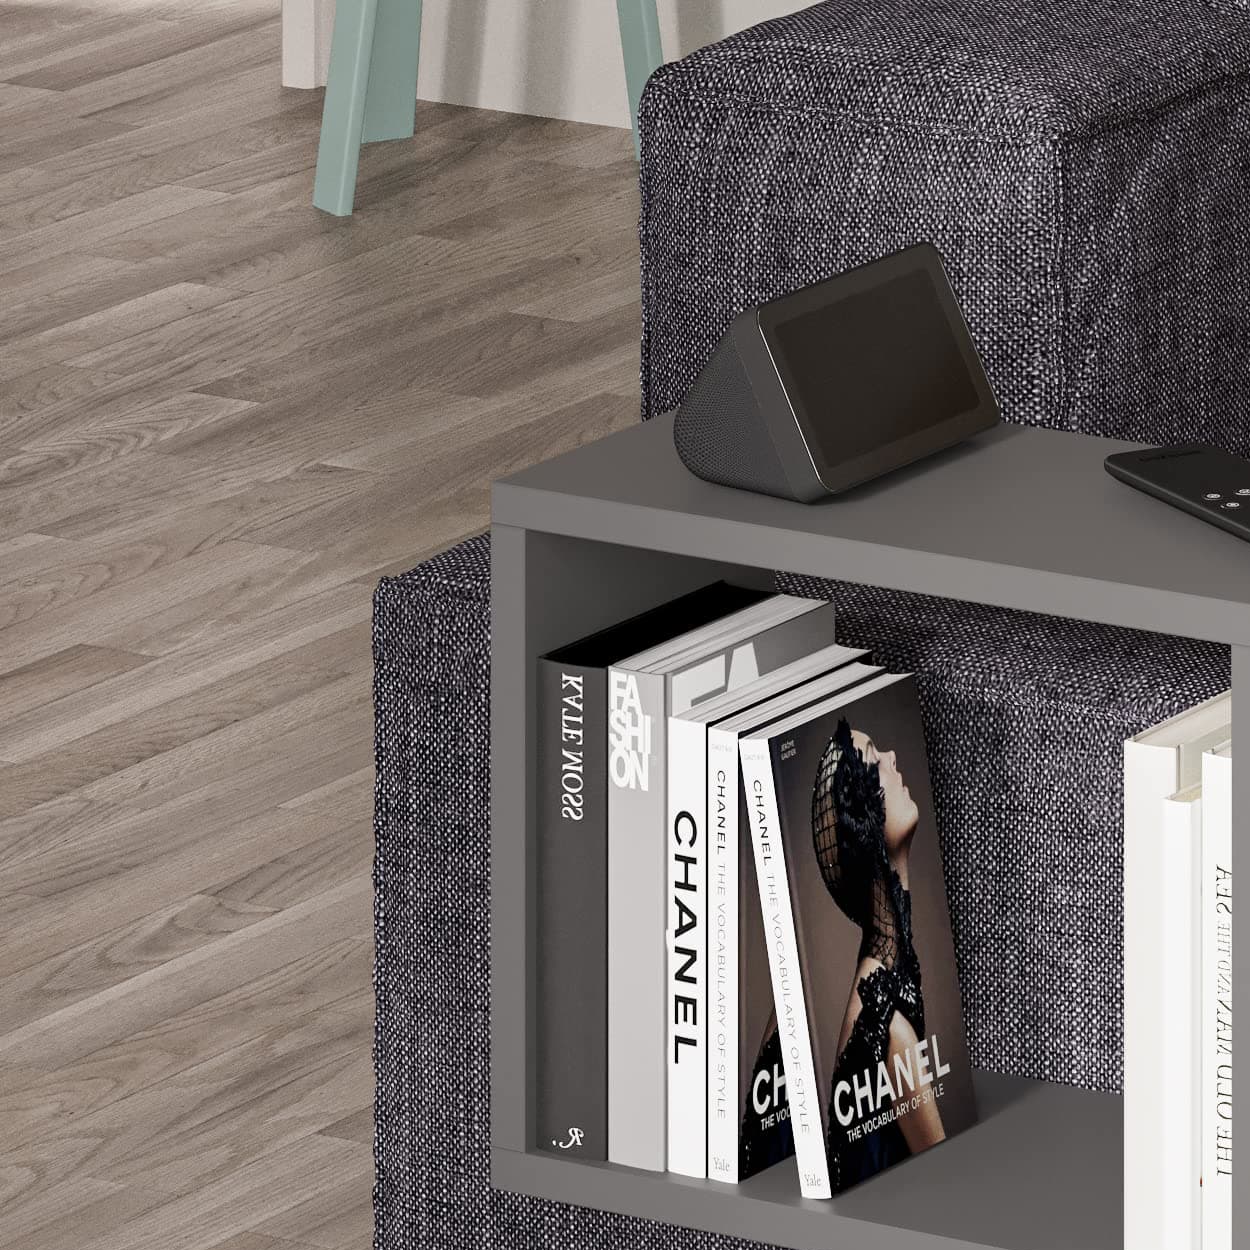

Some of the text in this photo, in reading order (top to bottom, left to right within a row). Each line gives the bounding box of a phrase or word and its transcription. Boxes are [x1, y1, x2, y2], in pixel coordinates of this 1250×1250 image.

[753, 779, 773, 866] CHANEL
[767, 874, 779, 907] THE
[674, 810, 698, 1065] CHANEL
[717, 770, 727, 1120] CHANEL THE VOCABULARY OF STYLE
[772, 913, 798, 1040] VOCABULARY
[790, 1046, 803, 1072] OF
[833, 1034, 951, 1127] CHANEL
[760, 1113, 775, 1131] THE
[795, 1078, 811, 1135] STYLE
[846, 1083, 945, 1143] THE VOCABULARY OF STYLE
[713, 1157, 731, 1172] Yale
[804, 1174, 821, 1187] Yale
